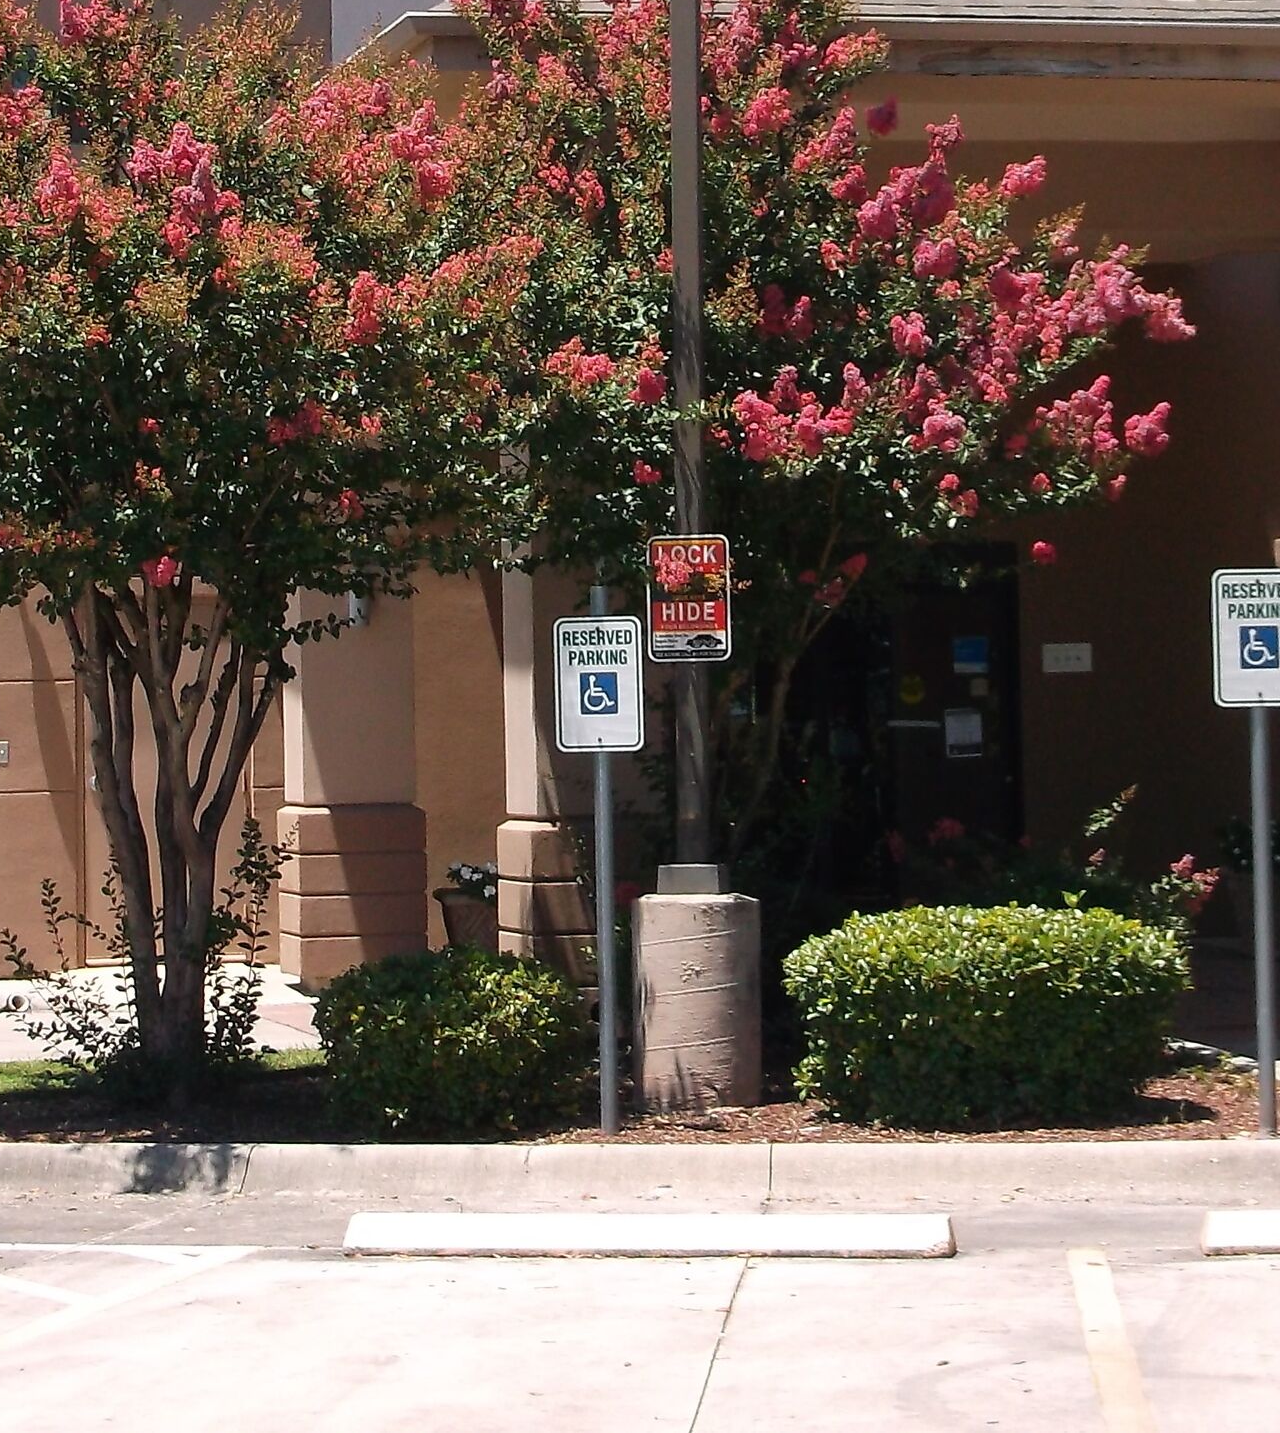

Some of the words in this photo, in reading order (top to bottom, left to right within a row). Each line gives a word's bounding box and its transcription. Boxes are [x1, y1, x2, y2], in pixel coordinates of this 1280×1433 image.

[662, 601, 716, 622] HIDE
[562, 629, 633, 647] RESERVED
[568, 649, 628, 666] PARKING
